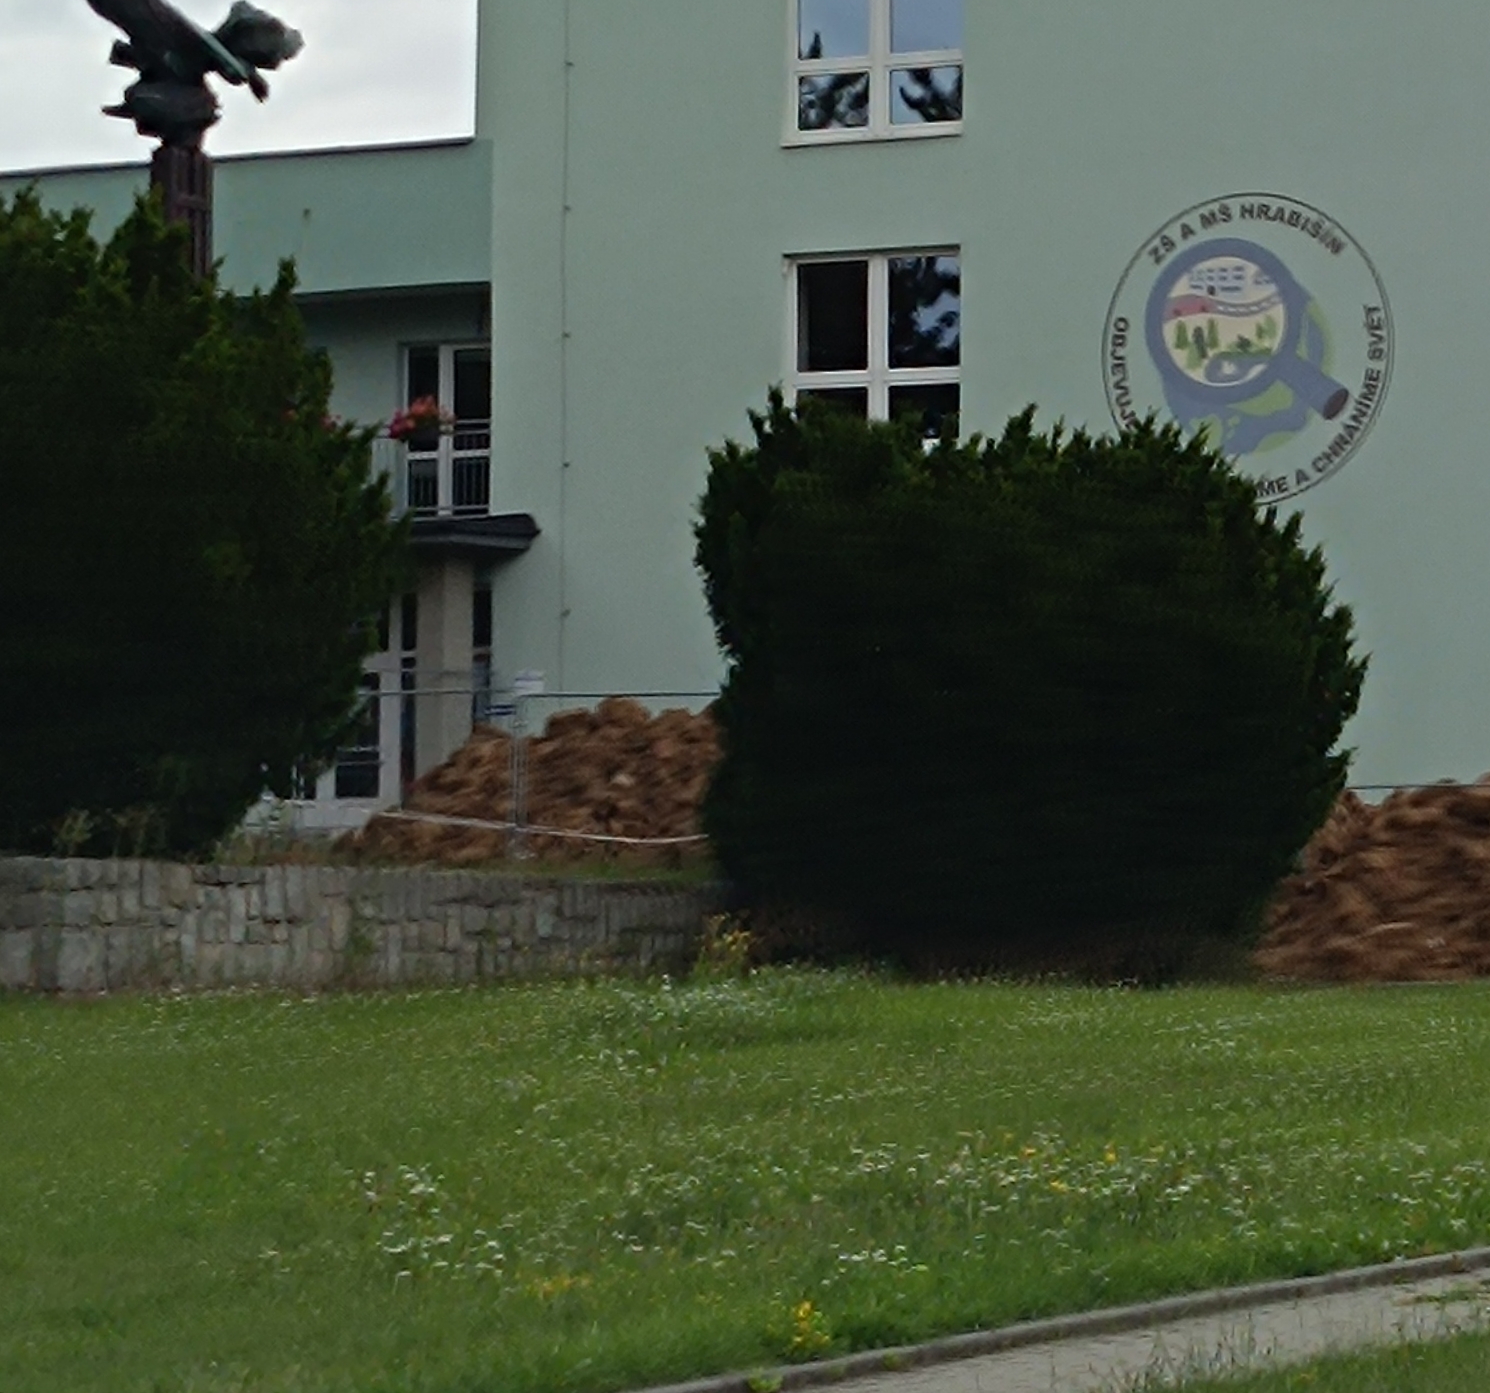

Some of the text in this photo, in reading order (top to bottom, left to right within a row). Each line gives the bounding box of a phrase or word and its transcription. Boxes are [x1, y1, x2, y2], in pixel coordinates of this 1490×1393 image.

[1180, 221, 1197, 241] A
[1199, 203, 1232, 230] MŠ
[1295, 468, 1311, 486] A
